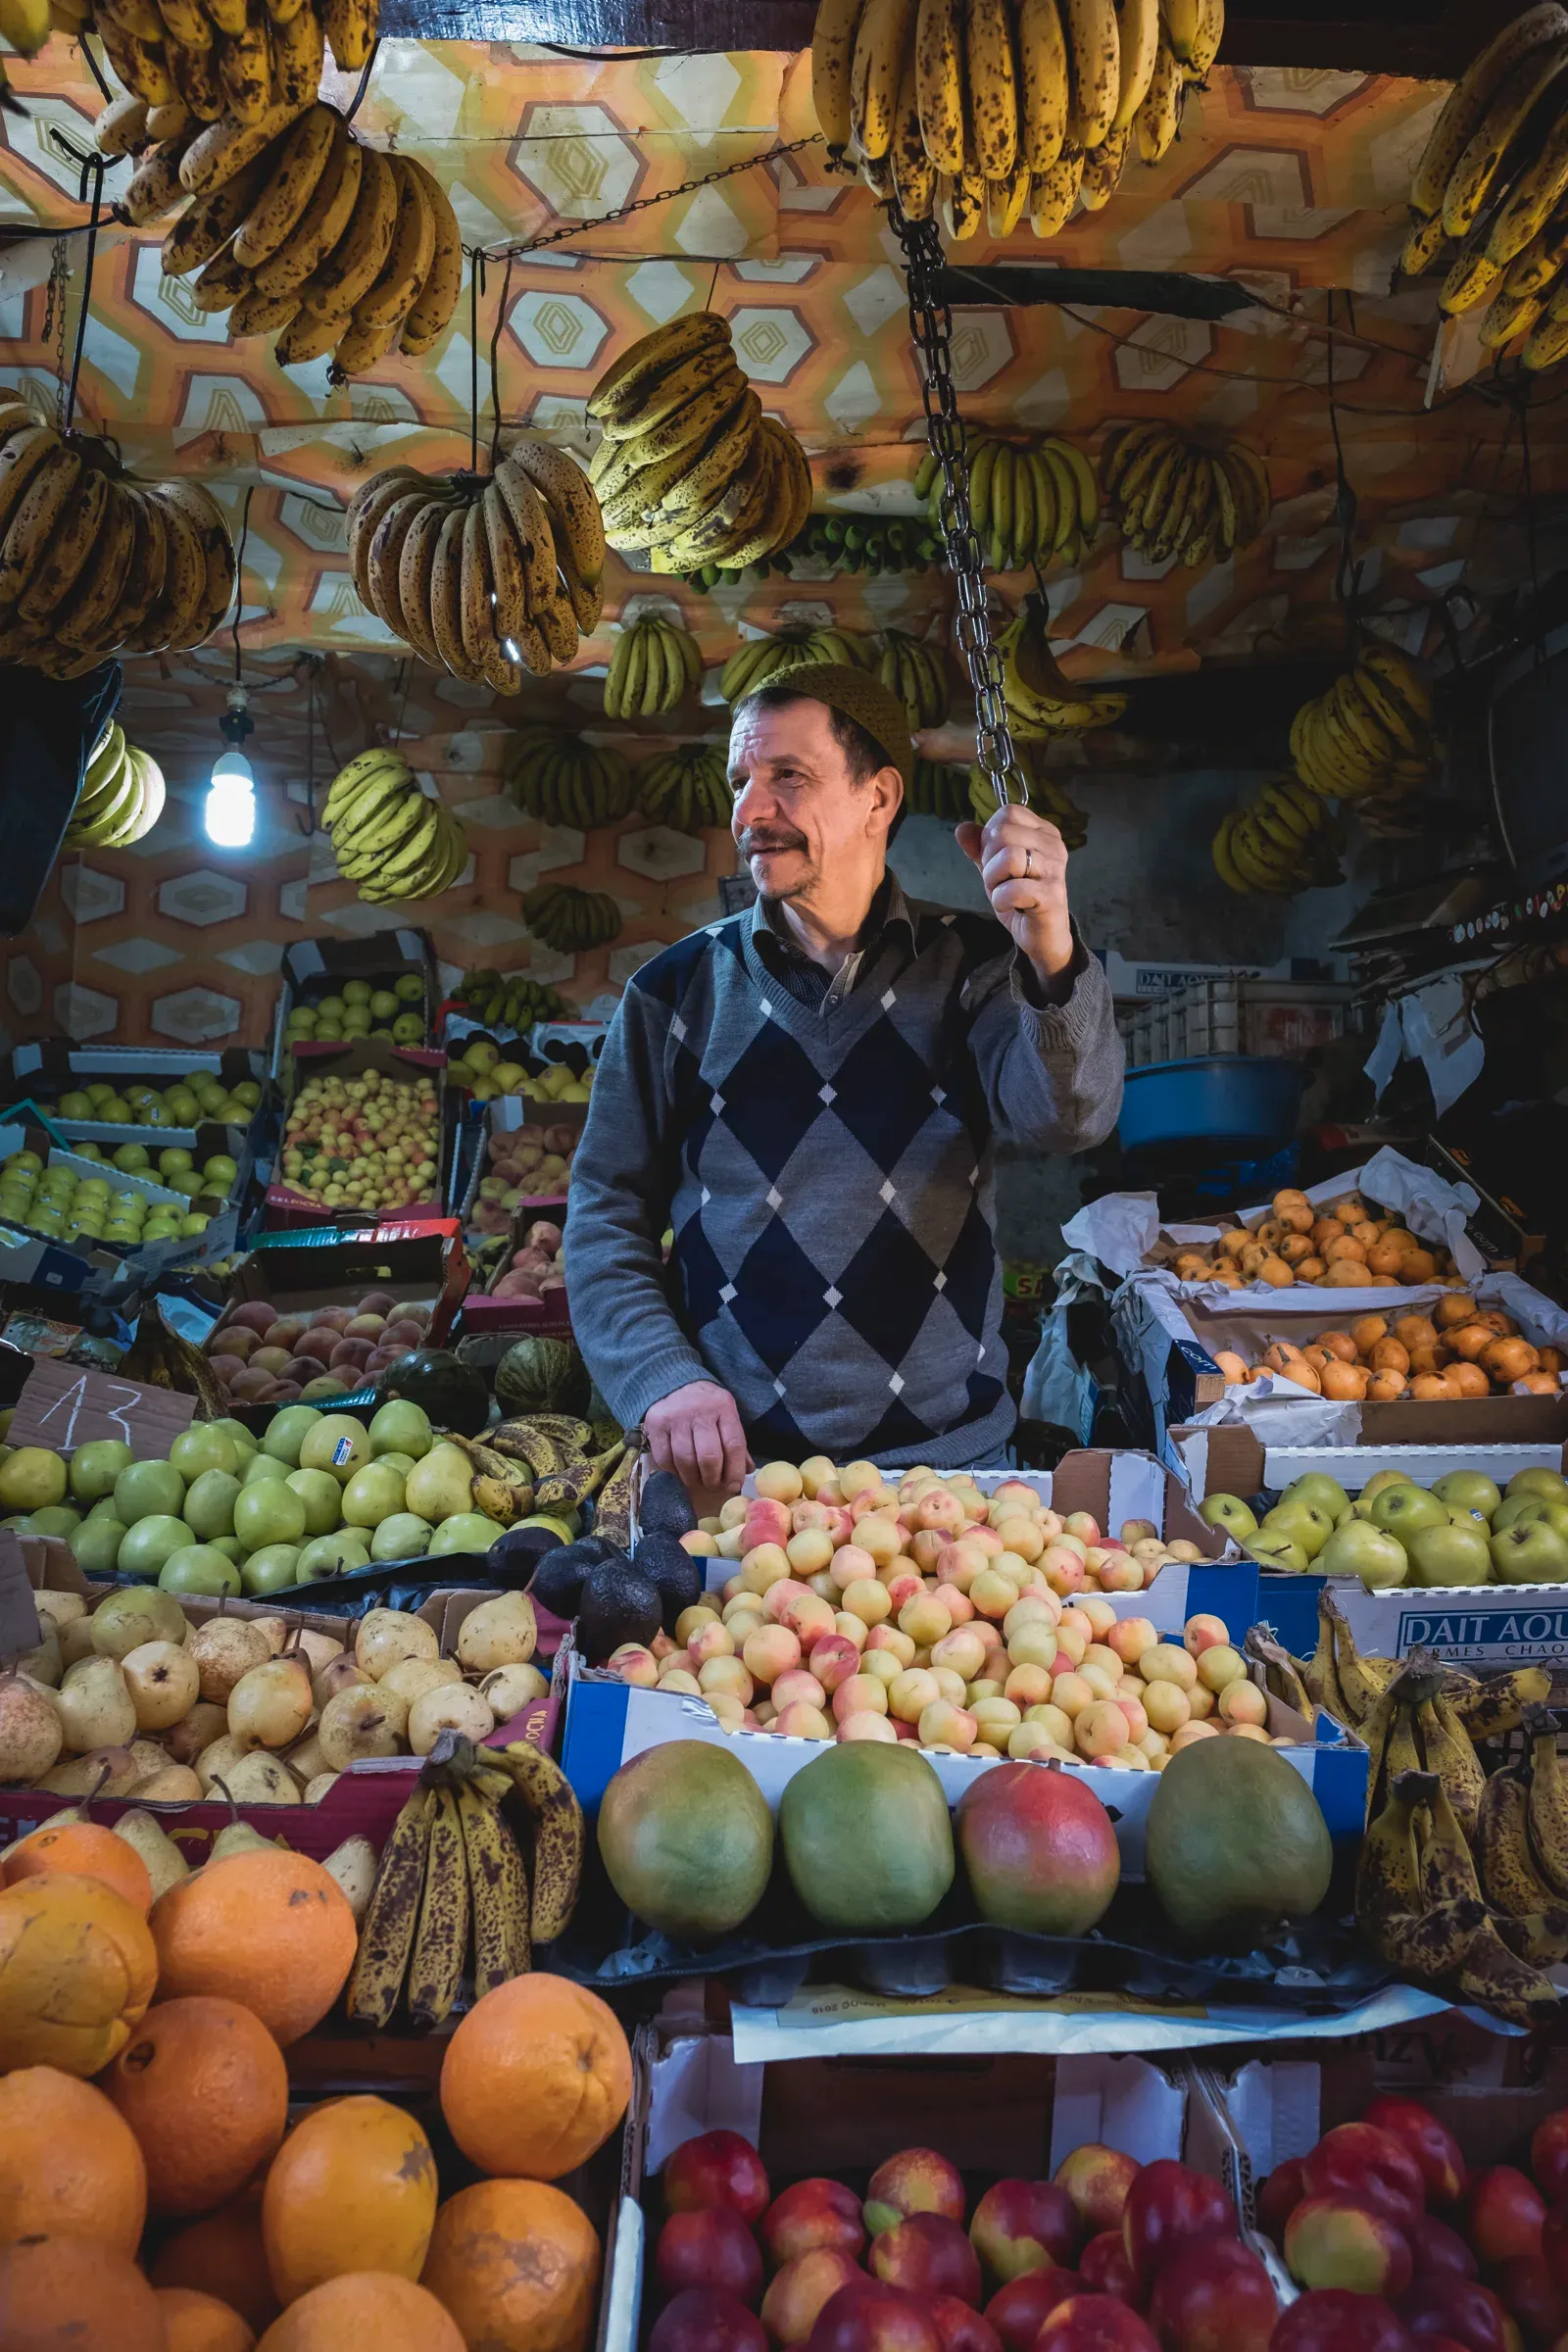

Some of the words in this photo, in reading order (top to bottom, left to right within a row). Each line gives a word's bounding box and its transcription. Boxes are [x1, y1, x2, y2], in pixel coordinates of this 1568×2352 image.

[1140, 972, 1173, 985] DAIT
[1406, 1617, 1490, 1644] DAIT
[1407, 1646, 1484, 1658] RMES
[1505, 1643, 1565, 1655] CHAO
[524, 1709, 548, 1743] OCHA
